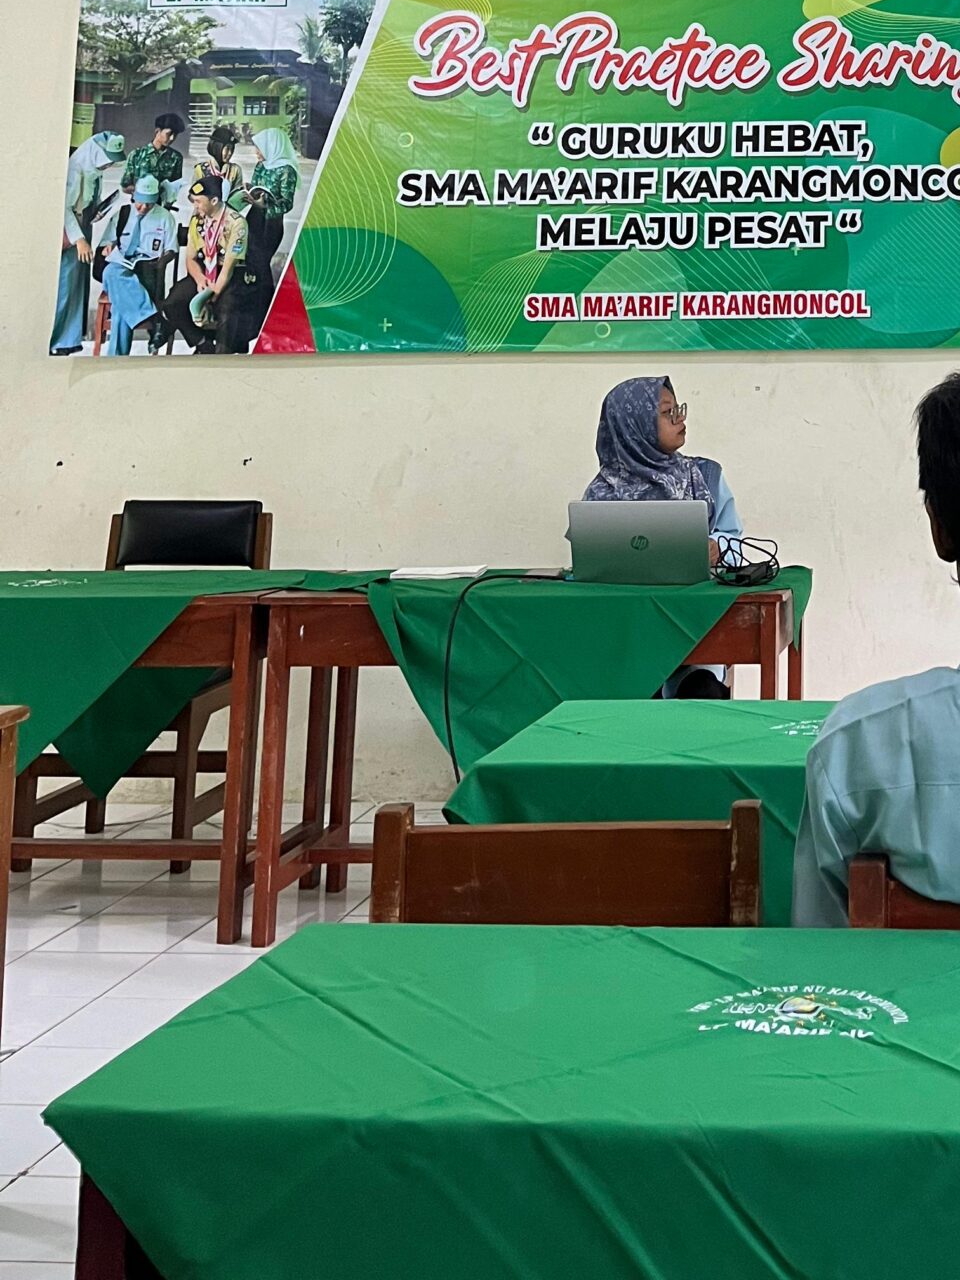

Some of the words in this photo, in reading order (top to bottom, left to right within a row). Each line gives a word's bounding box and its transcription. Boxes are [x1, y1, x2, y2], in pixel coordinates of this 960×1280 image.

[411, 14, 556, 106] Best
[550, 14, 766, 106] Practice
[560, 124, 722, 156] GURUKU
[734, 123, 871, 158] HEBAT,
[400, 172, 486, 202] SMA
[540, 215, 695, 247] MELAJU
[707, 214, 829, 245] PESAT
[526, 296, 576, 318] SMA
[682, 292, 868, 317] KARANGMONCOL
